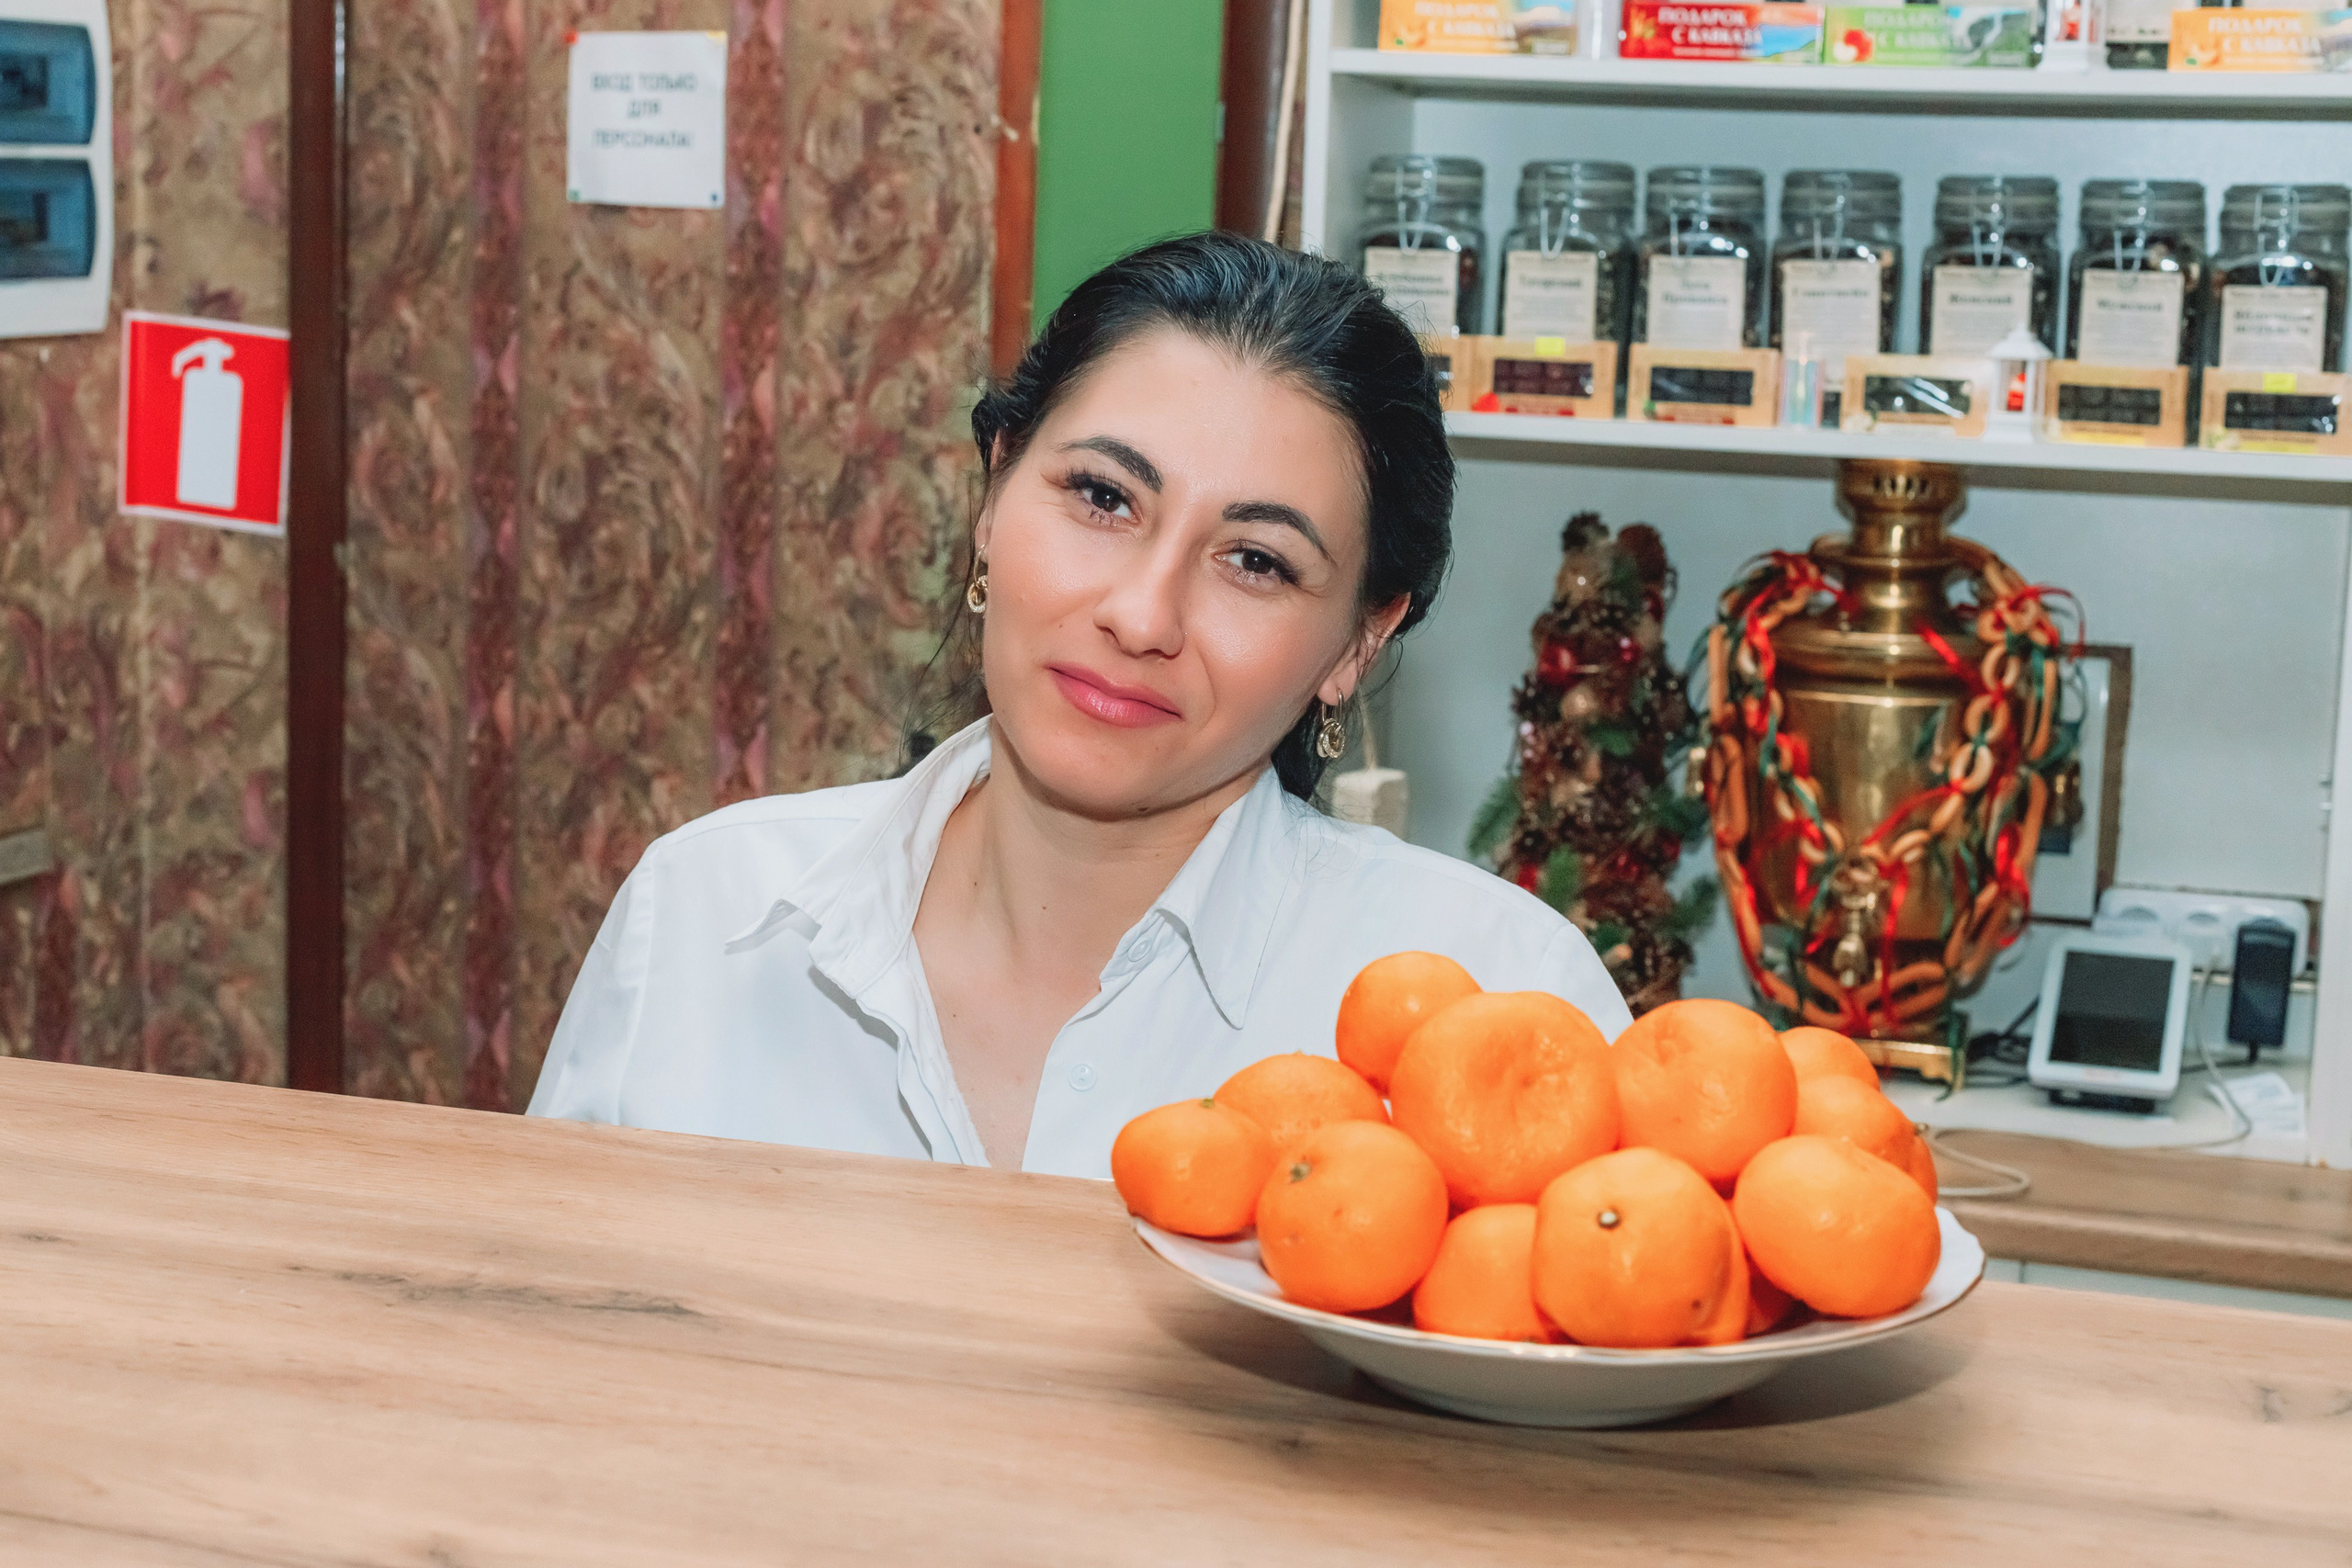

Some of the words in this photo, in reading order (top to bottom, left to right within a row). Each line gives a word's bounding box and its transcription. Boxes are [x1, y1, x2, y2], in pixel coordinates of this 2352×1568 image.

[1658, 7, 1747, 25] ПОДАРОК
[2208, 17, 2302, 33] ПОДАРОК
[1671, 27, 1684, 44] С
[1688, 28, 1763, 45] КАВКАЗА
[2222, 37, 2233, 52] С
[2240, 37, 2321, 53] КАВКАЗА
[593, 73, 631, 91] ВХОД
[639, 73, 696, 91] ТОЛЬКО
[628, 100, 661, 118] ДЛЯ
[594, 130, 692, 147] ПЕРСОНАЛА
